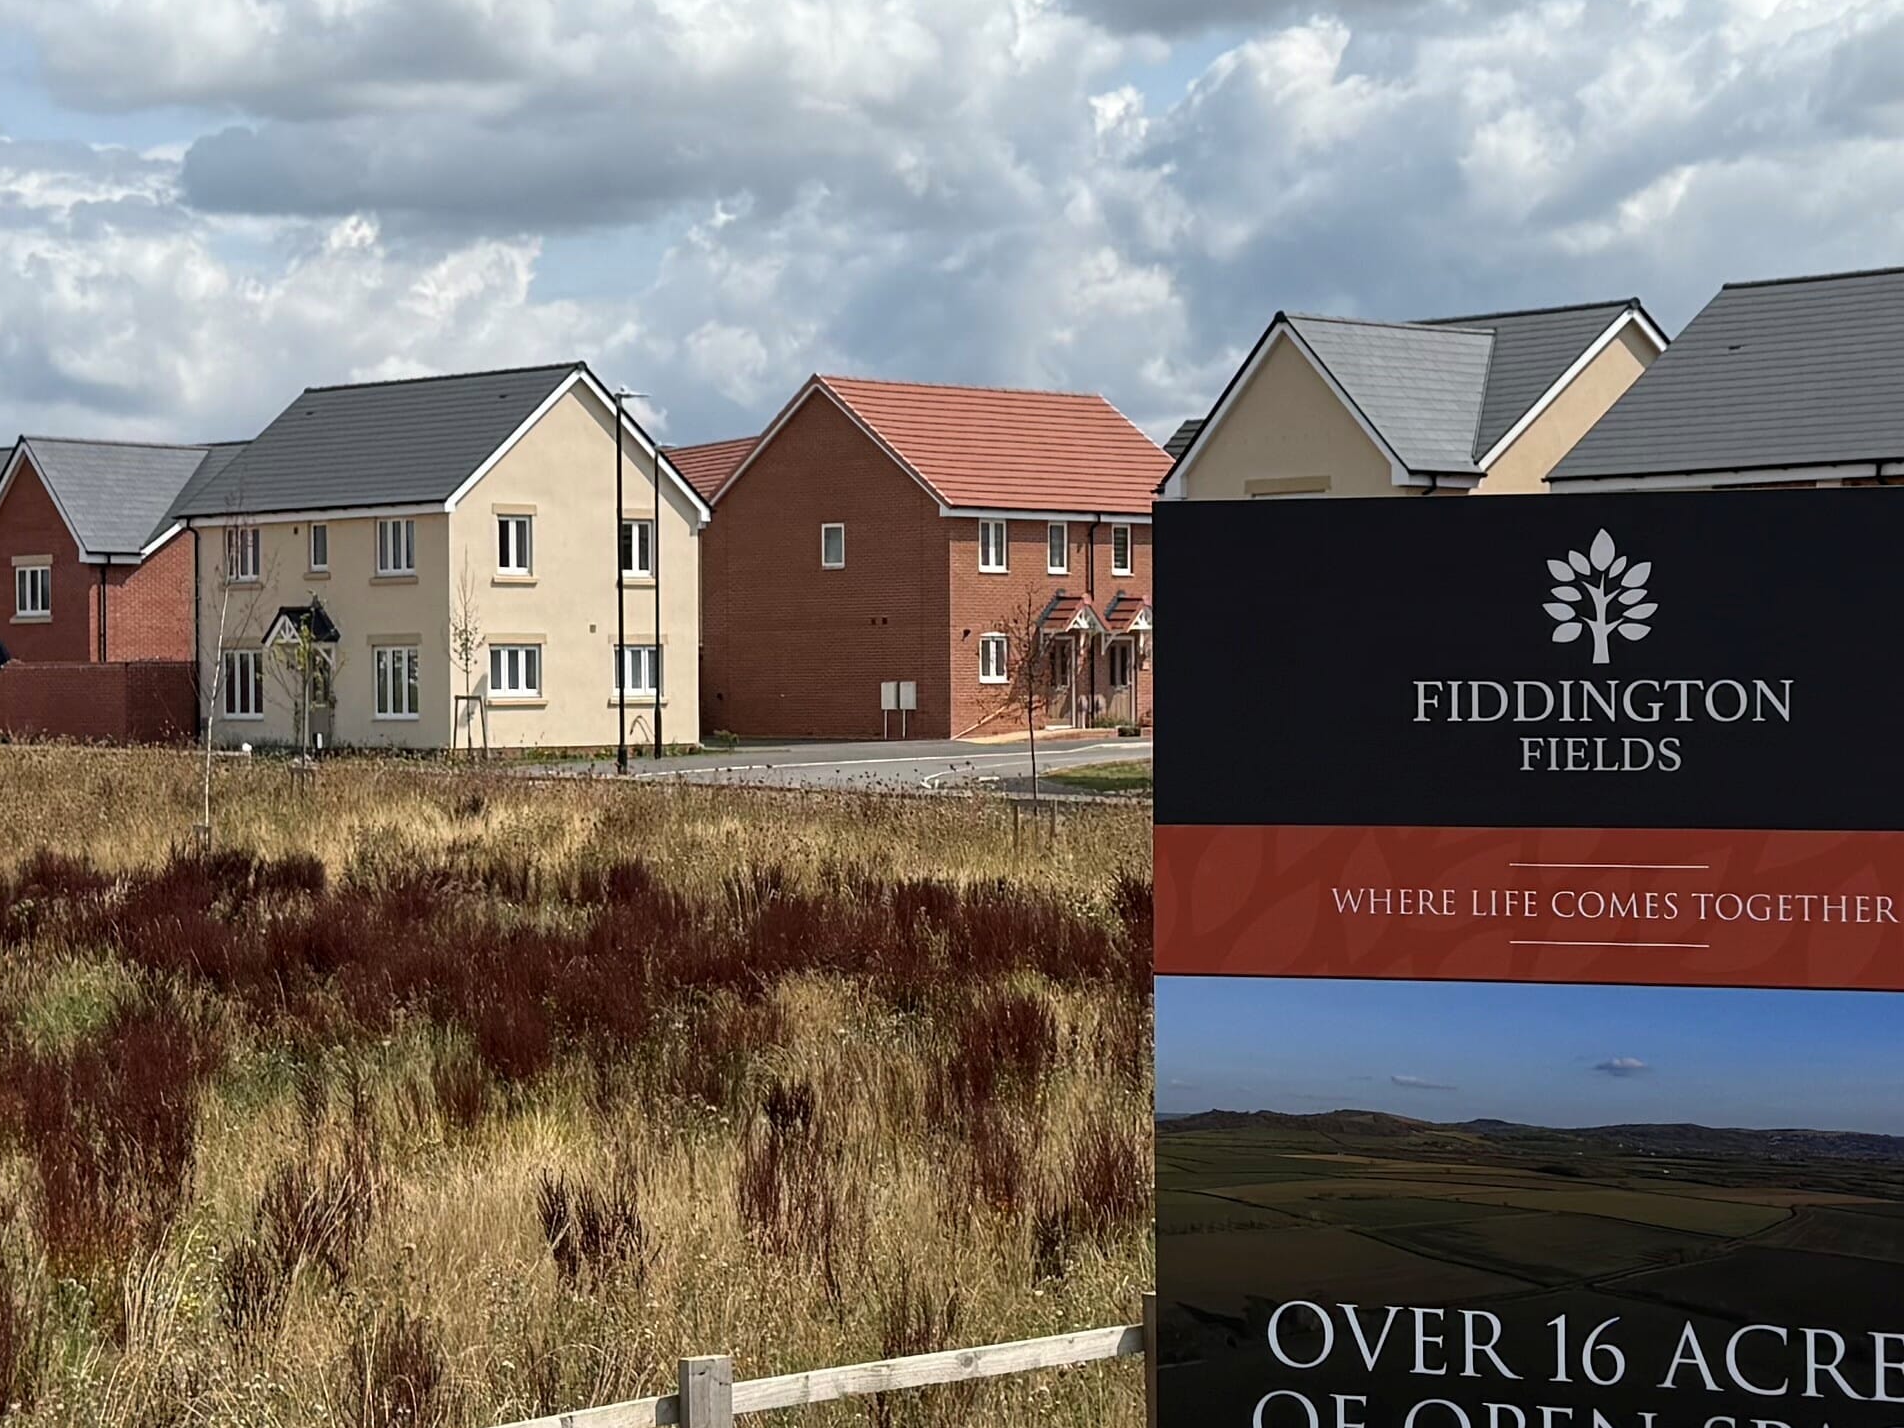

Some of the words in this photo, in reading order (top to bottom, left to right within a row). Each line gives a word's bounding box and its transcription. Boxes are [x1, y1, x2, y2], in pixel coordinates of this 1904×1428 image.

[1414, 679, 1794, 722] FIDDINGTON
[1519, 737, 1681, 773] FIELDS
[1331, 887, 1456, 916] WHERE
[1472, 889, 1539, 918] LIFE
[1551, 891, 1679, 920] COMES
[1694, 893, 1899, 923] TOGETHER
[1267, 1300, 1524, 1380] OVER
[1546, 1314, 1626, 1386] 16
